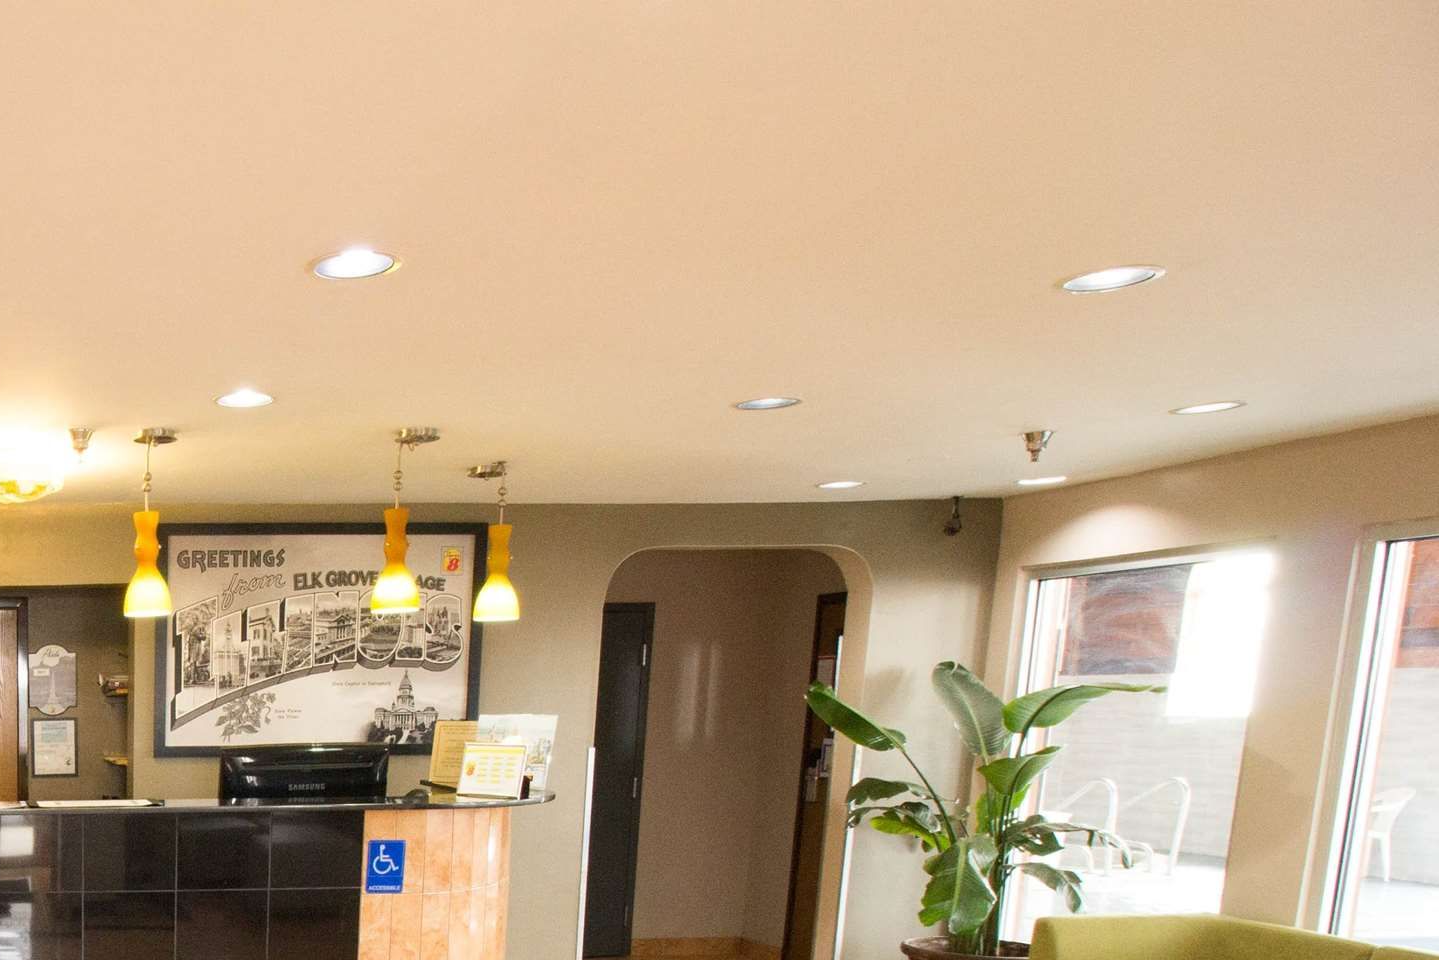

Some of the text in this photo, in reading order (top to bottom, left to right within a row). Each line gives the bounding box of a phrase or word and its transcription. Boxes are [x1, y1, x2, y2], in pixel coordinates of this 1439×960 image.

[177, 549, 285, 573] GREETINGS
[222, 570, 379, 610] from ELK GROVE
[171, 590, 464, 731] ILLINOIS
[288, 783, 326, 791] SAMSUNG
